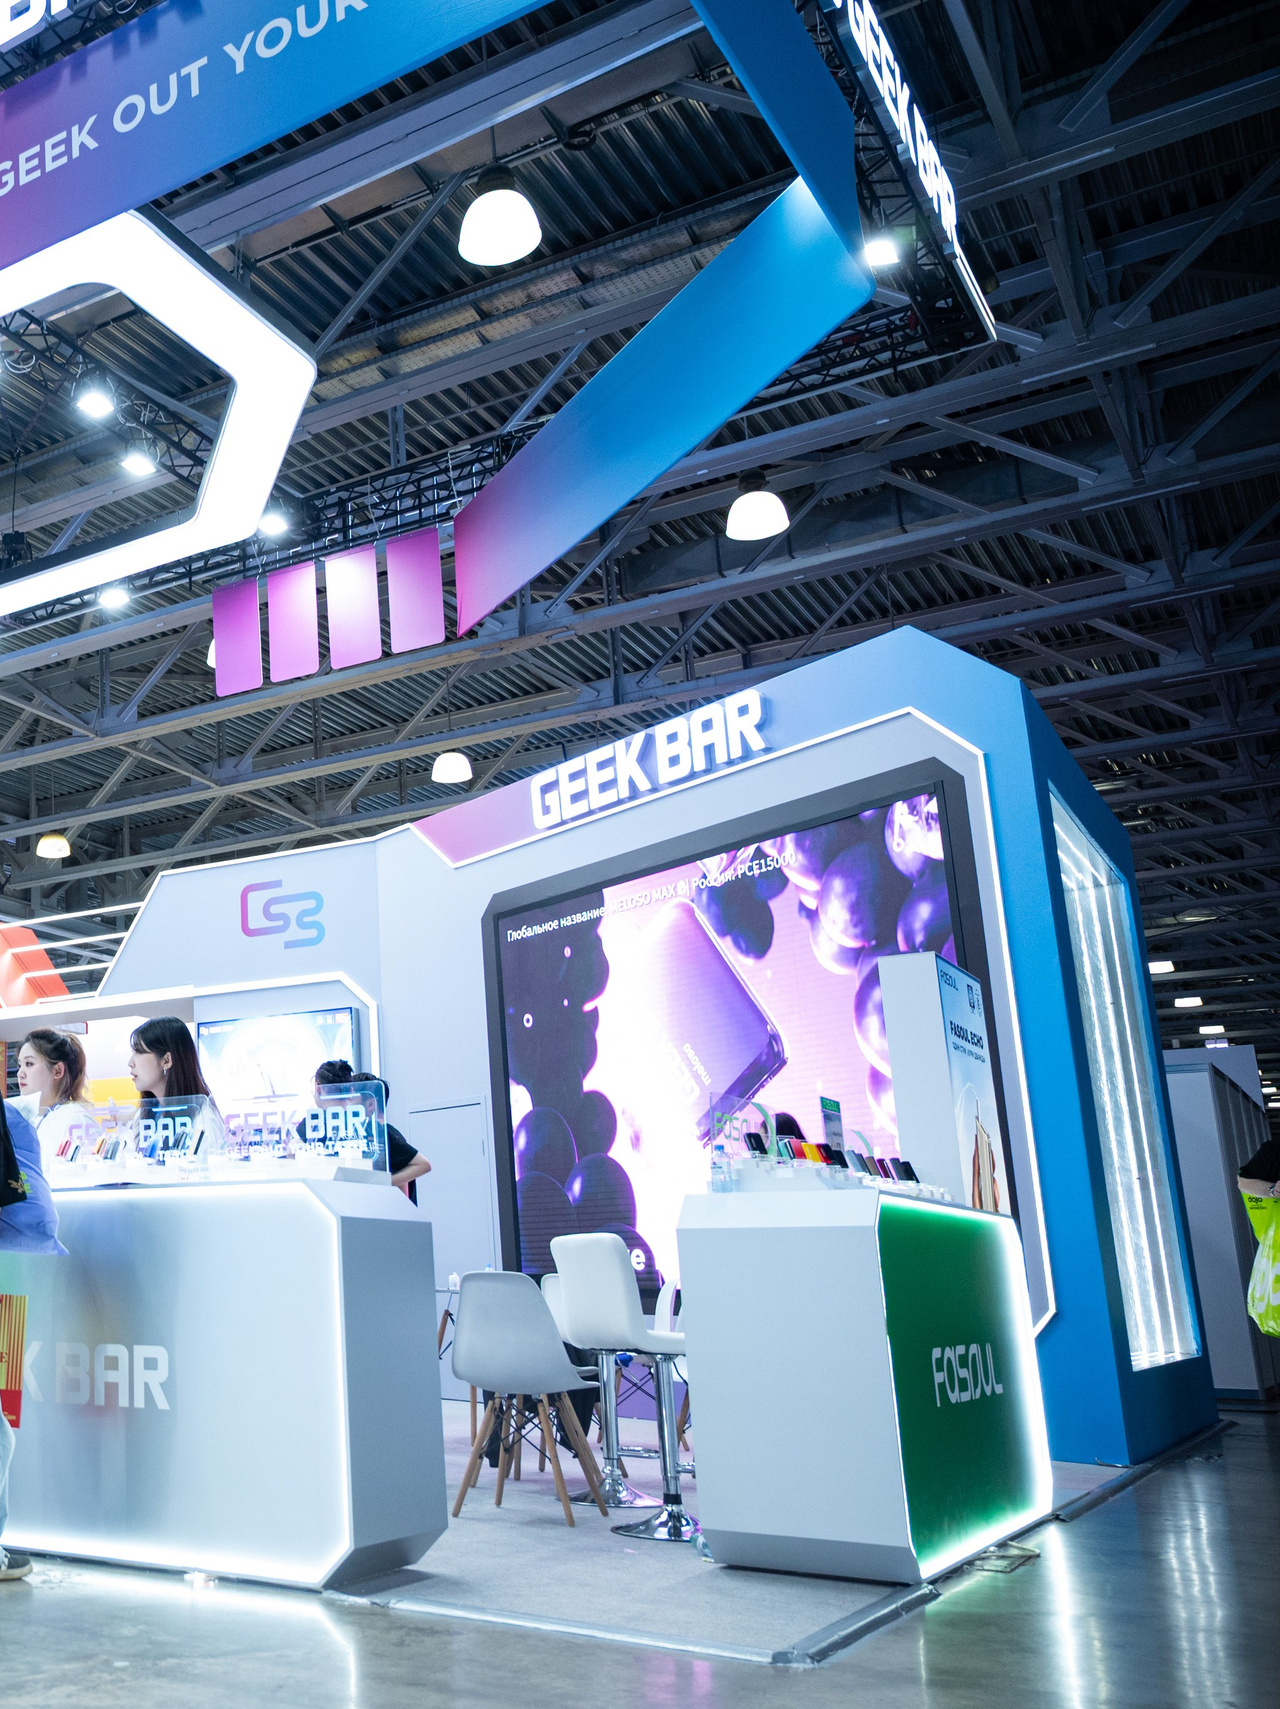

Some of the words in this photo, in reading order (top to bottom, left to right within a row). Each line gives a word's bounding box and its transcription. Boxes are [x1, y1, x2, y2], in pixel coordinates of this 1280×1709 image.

[112, 57, 209, 133] OUT
[913, 103, 957, 242] BAR
[531, 732, 651, 829] GEEK
[654, 688, 766, 785] BAR
[506, 920, 559, 942] Глобальное
[611, 893, 652, 914] MELOSO
[652, 884, 676, 901] MAX
[305, 1103, 368, 1140] BAR
[55, 1341, 170, 1411] BAR
